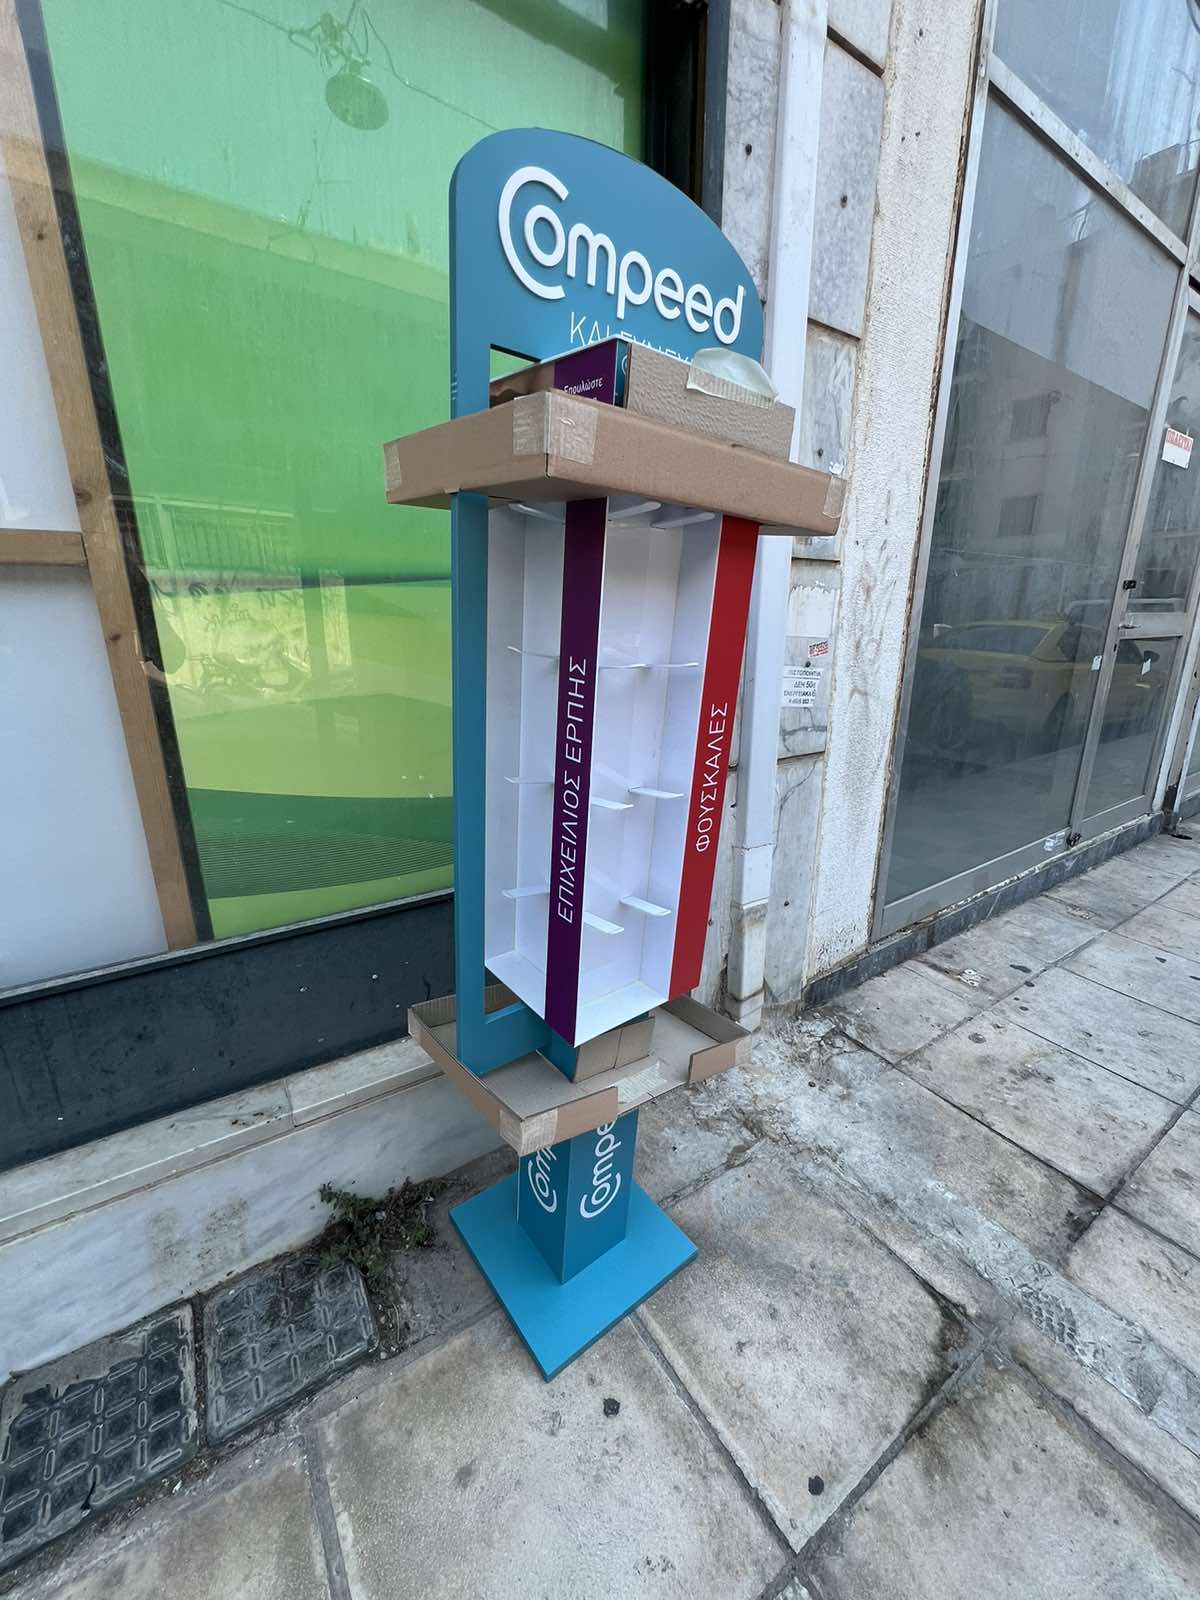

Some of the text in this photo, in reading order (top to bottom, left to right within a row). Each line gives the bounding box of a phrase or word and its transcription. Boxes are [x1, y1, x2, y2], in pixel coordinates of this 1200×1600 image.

[498, 166, 746, 345] Compeed
[557, 656, 587, 924] ΕΠΙΧΕΙΛΙΟΣ ΕΡΠΗΣ
[695, 702, 728, 853] ΦΟΥΣΚΑΛΕΣ
